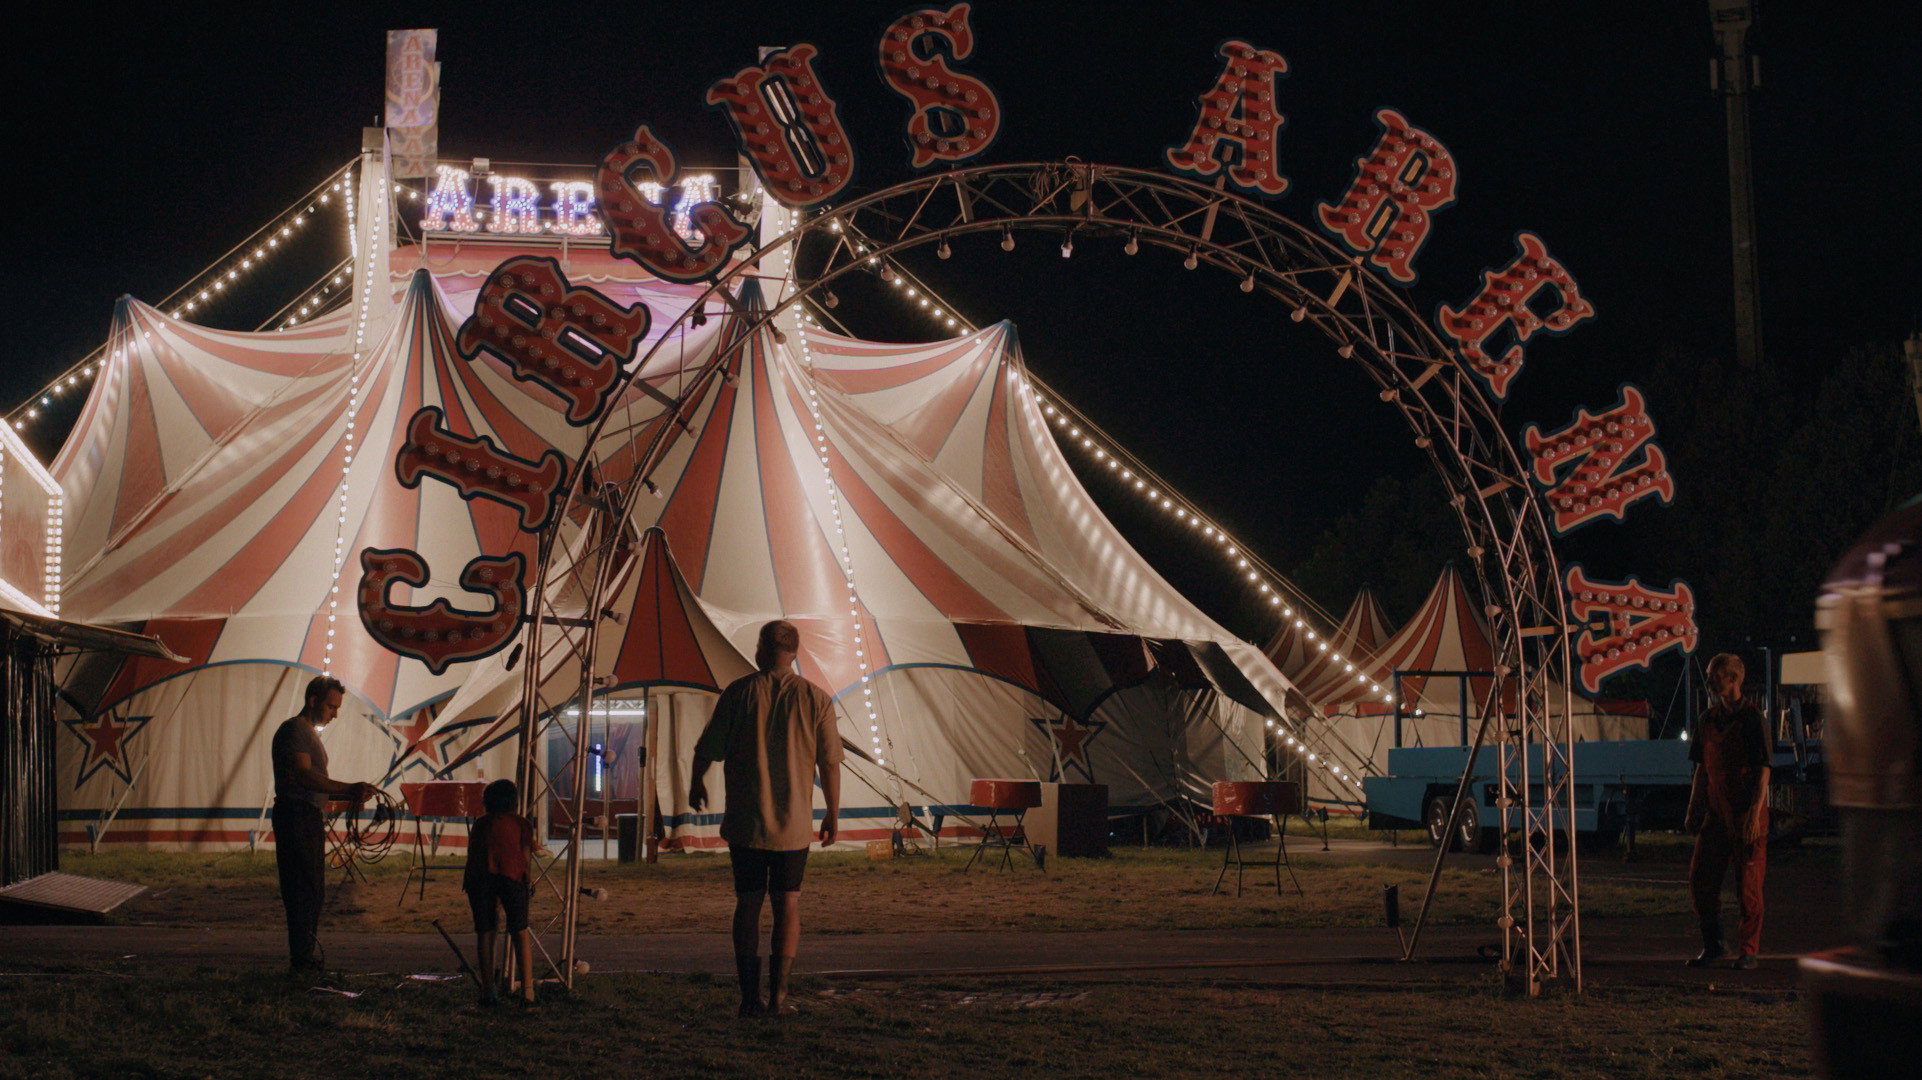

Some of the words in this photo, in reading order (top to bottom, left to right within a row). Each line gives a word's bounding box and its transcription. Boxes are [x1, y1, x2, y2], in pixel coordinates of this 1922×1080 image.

[359, 4, 1003, 674] CIRCUS
[1165, 39, 1699, 694] ARENA
[419, 164, 717, 238] AREA
